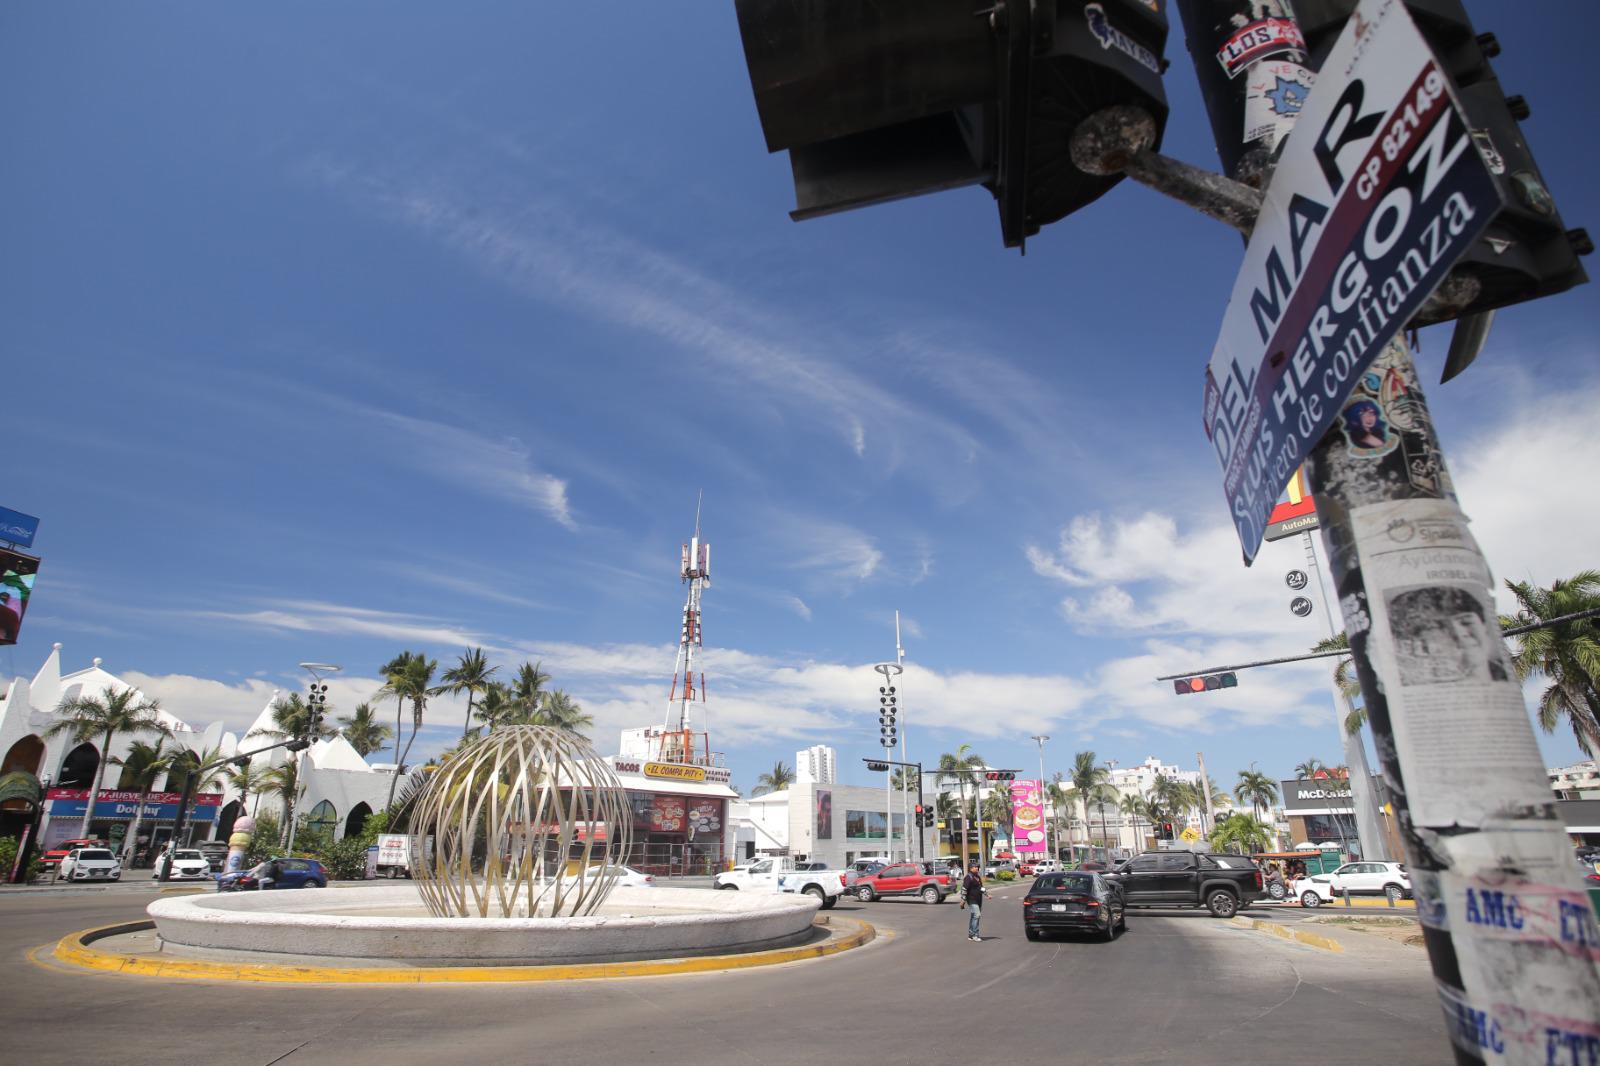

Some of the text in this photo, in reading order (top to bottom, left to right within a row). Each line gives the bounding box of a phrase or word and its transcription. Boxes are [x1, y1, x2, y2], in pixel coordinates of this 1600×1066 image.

[1226, 26, 1272, 59] LOS
[1356, 155, 1382, 200] CP
[1381, 69, 1444, 162] 82149
[1213, 78, 1389, 474] DEL MAR
[1272, 105, 1471, 425] HERGOZ
[1298, 393, 1324, 439] de
[1323, 191, 1477, 399] confianza
[108, 791, 141, 801] JUEVE
[615, 762, 699, 778] TACOS EL COMPA PITY
